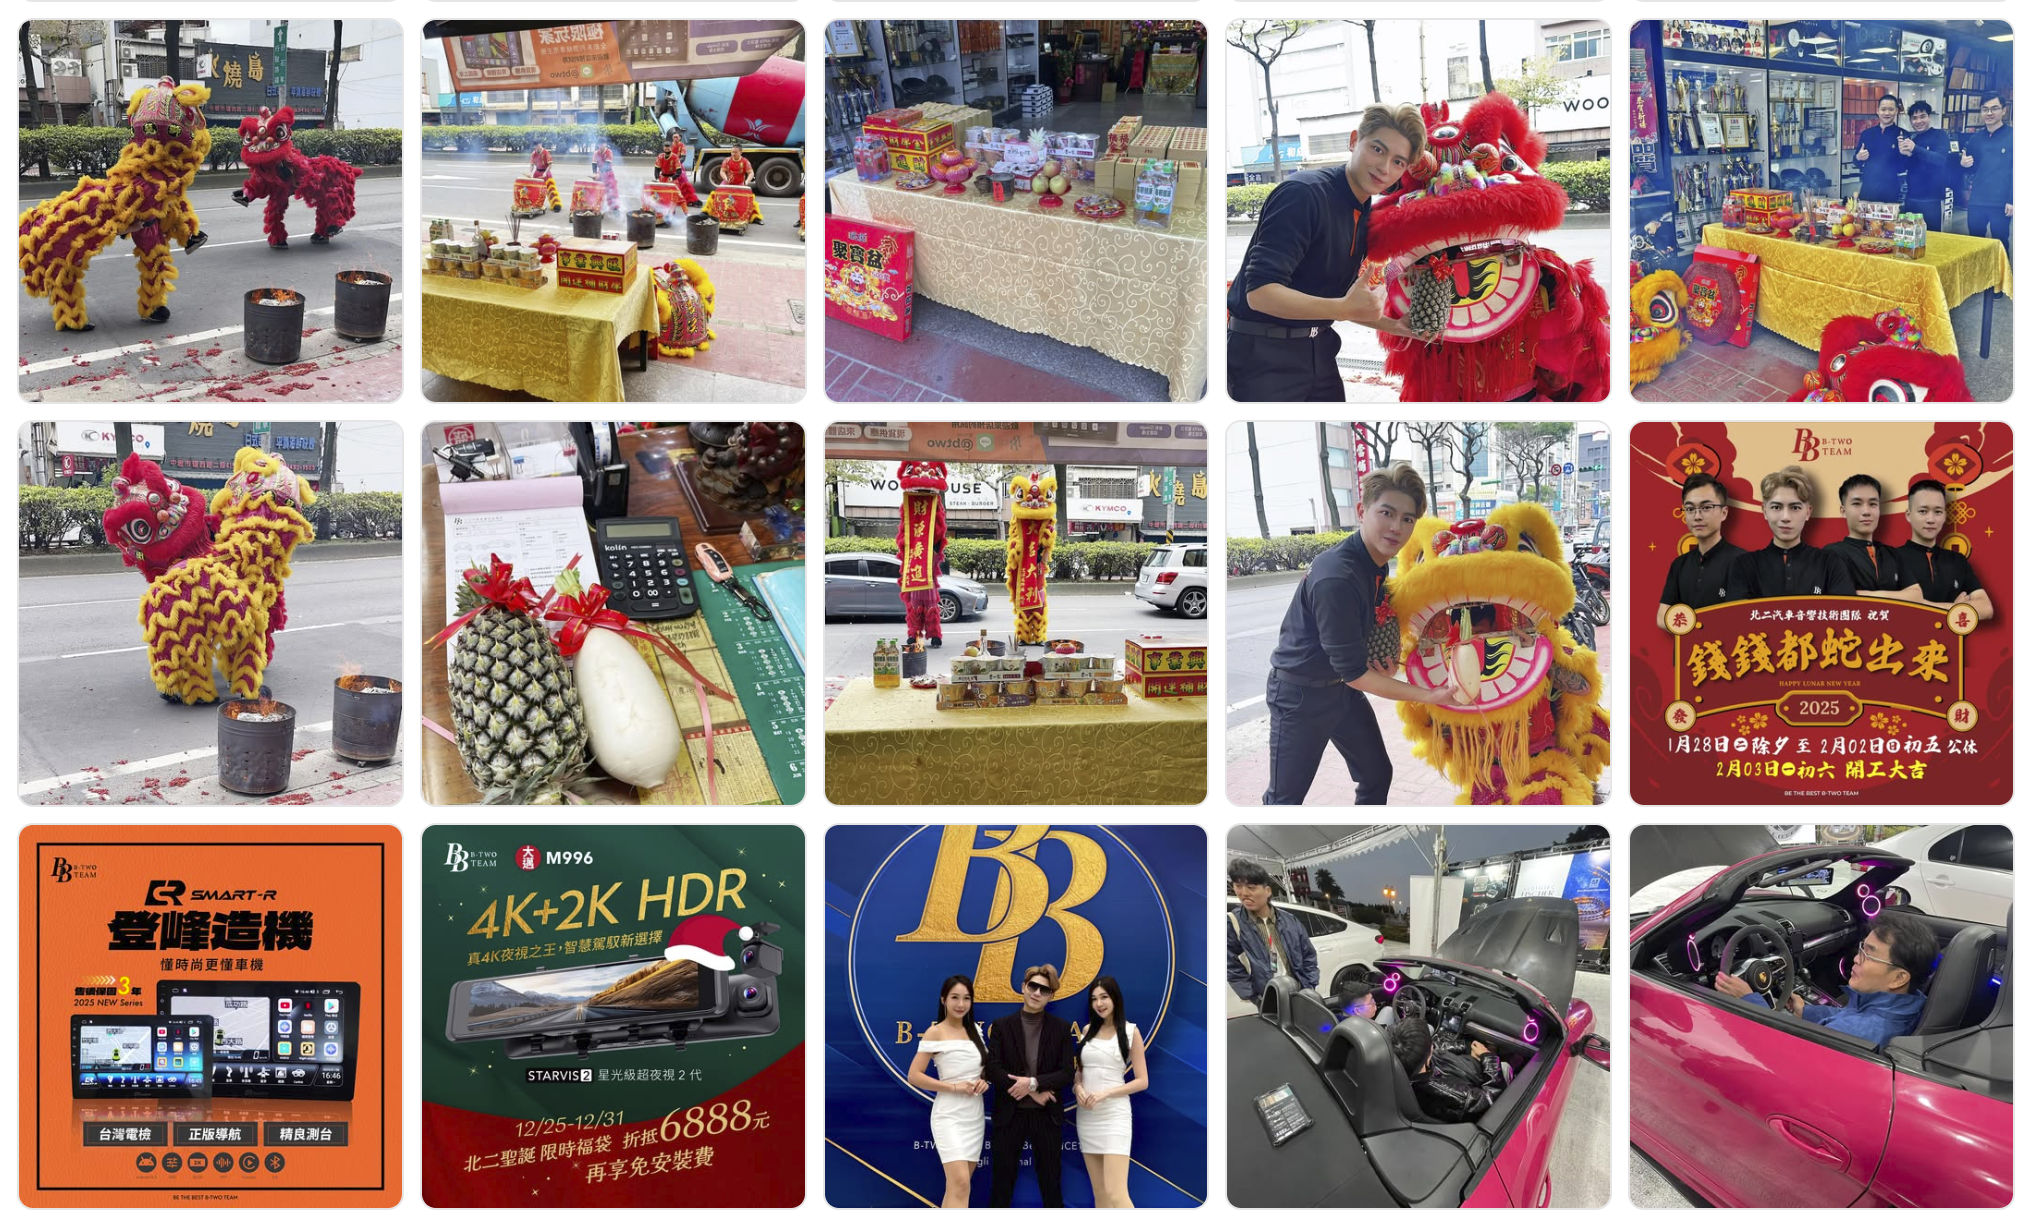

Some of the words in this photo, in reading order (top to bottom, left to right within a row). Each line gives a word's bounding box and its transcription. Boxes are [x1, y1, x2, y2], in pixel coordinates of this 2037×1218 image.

[1563, 97, 1609, 112] WOO
[833, 240, 882, 269] 聚寶盆
[604, 544, 628, 552] kolin
[647, 579, 655, 587] 2
[1672, 612, 1688, 628] 恭
[1750, 609, 1862, 621] 北二汽車音響技術團隊
[1867, 609, 1889, 621] 祝賀
[1955, 612, 1970, 628] 喜
[1686, 627, 1949, 687] 錢錢都蛇出來
[1672, 708, 1688, 724] 發
[1799, 700, 1840, 716] 2025
[1954, 708, 1970, 724] 財
[1796, 738, 1811, 753] 至
[1947, 738, 1978, 754] 公休
[1845, 759, 1928, 780] 開工大吉
[470, 859, 497, 867] TEAM
[546, 851, 594, 865] M996
[190, 889, 277, 901] SMART-R
[467, 881, 623, 939] 4K+2K
[637, 867, 748, 921] HDR
[107, 910, 313, 951] 登峰造機
[160, 957, 264, 972] 懂時尚更懂車機
[74, 998, 95, 1007] 2025
[97, 998, 118, 1007] NEW
[120, 998, 143, 1007] Series
[515, 1110, 624, 1138] 12/25-12/31
[99, 1127, 152, 1141] 台灣電檢
[188, 1127, 242, 1141] 正版導航
[279, 1127, 333, 1141] 精良測台
[464, 1147, 536, 1172] 北二聖誕
[540, 1135, 612, 1162] 限時福袋
[585, 1145, 714, 1184] 再享免安裝費
